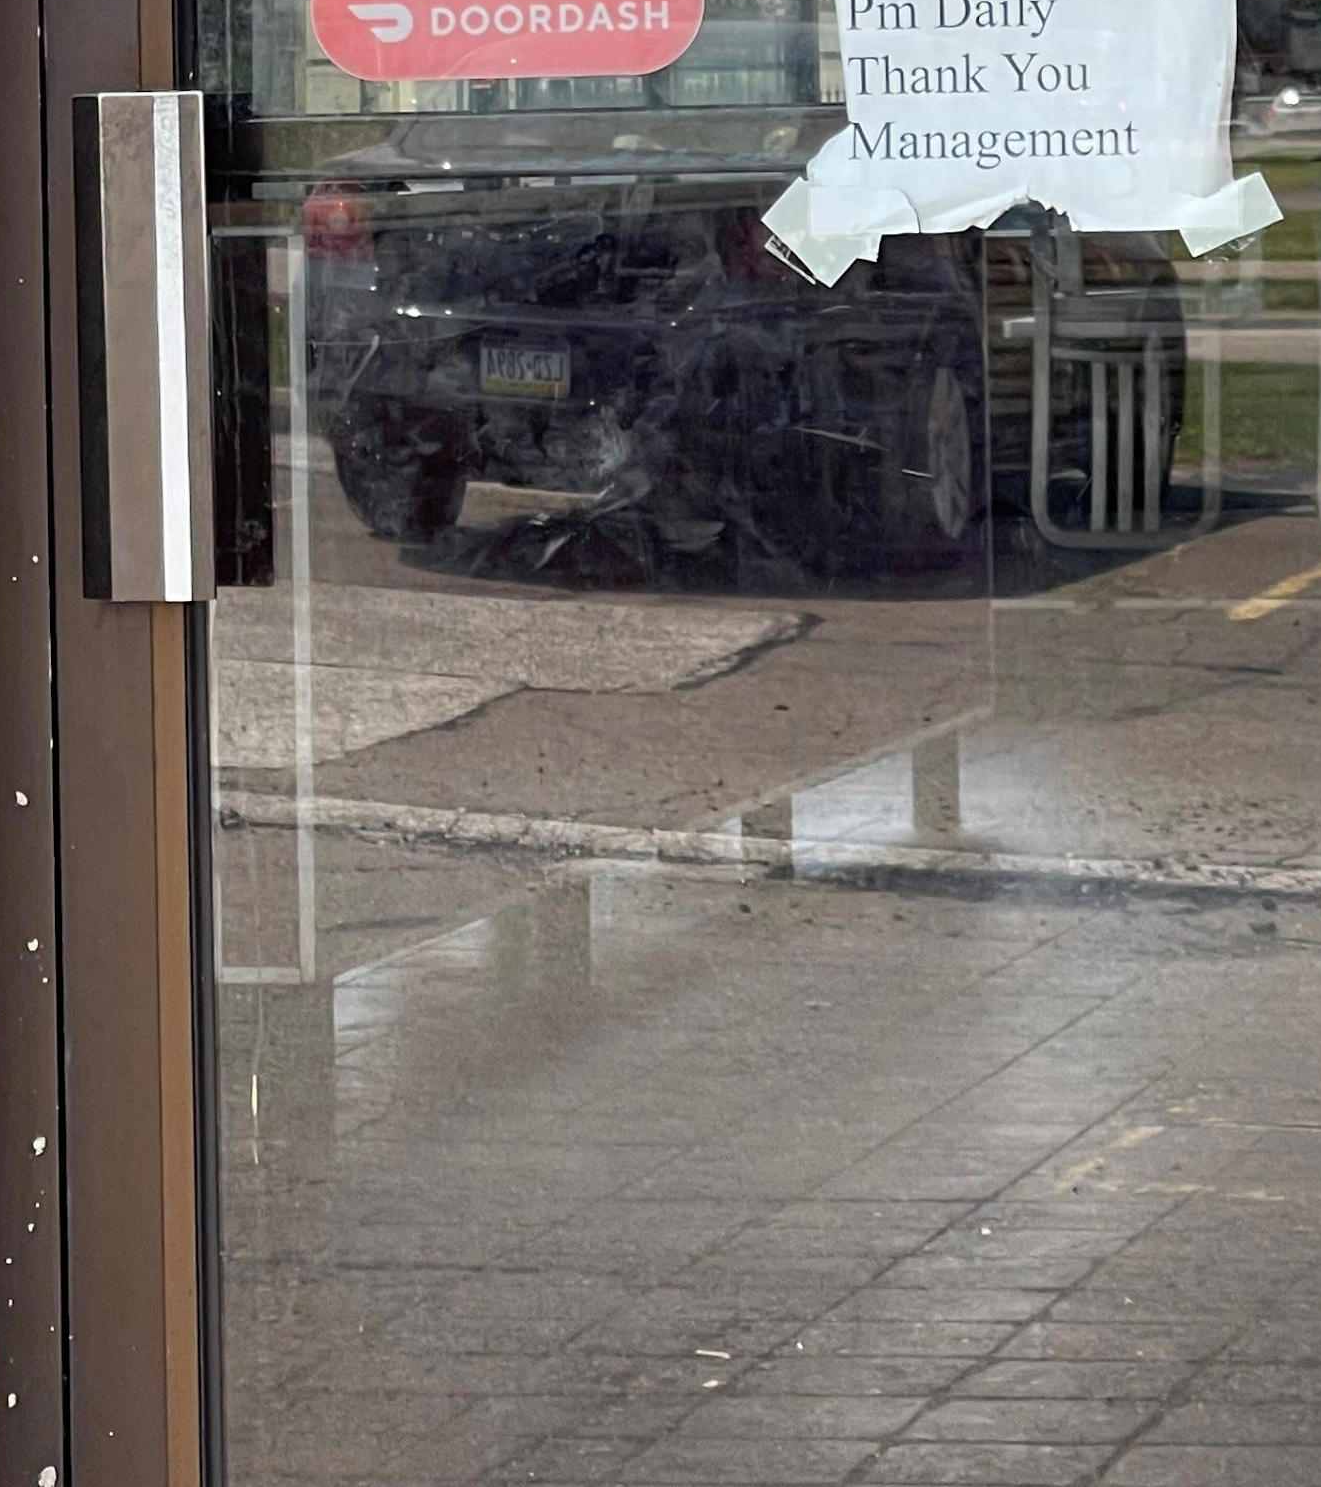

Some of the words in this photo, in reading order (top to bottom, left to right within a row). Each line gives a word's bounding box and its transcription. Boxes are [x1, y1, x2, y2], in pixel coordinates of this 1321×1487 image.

[431, 1, 669, 35] DOORDASH
[848, 54, 988, 95] Thank
[1002, 53, 1089, 91] You
[849, 119, 1140, 169] Management
